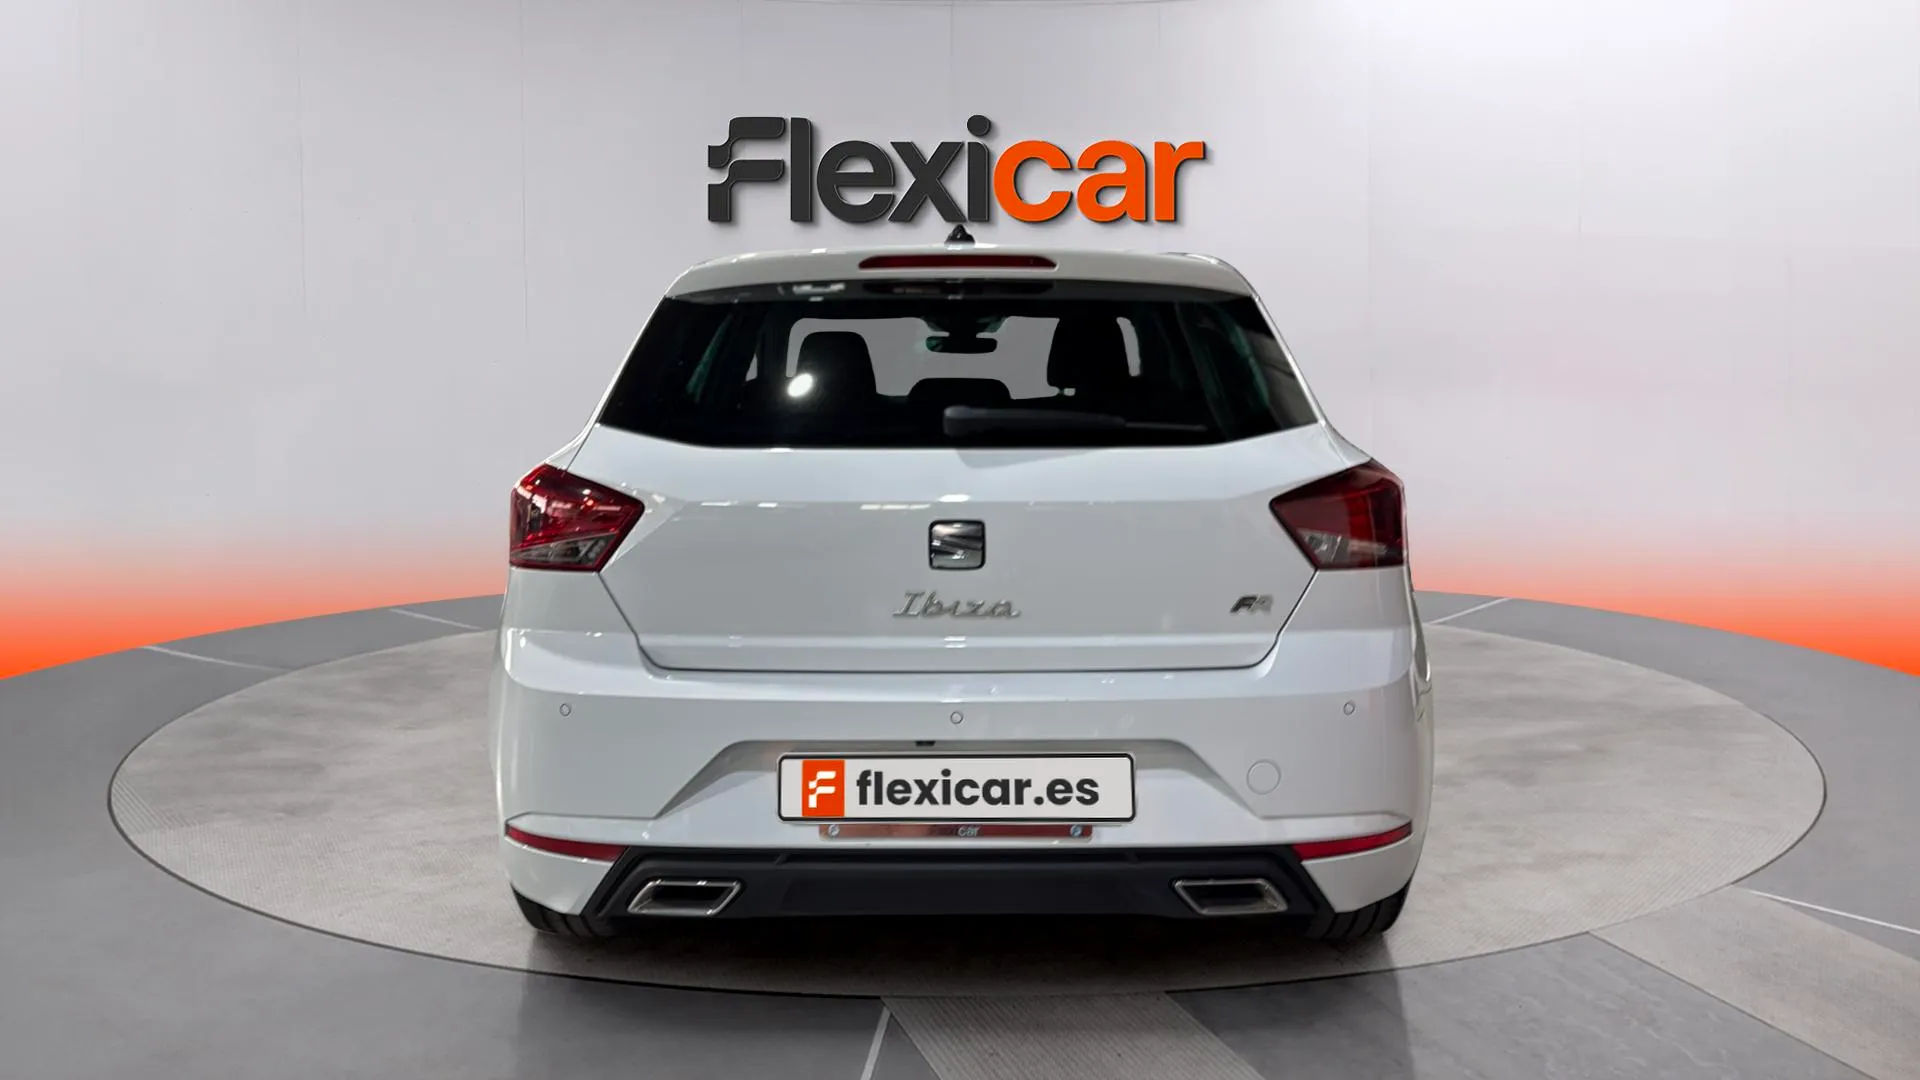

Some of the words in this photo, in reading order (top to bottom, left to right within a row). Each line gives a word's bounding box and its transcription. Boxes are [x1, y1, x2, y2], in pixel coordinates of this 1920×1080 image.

[893, 590, 1021, 618] Ibiza
[1229, 595, 1274, 614] FR
[857, 769, 1099, 806] flexicar.es
